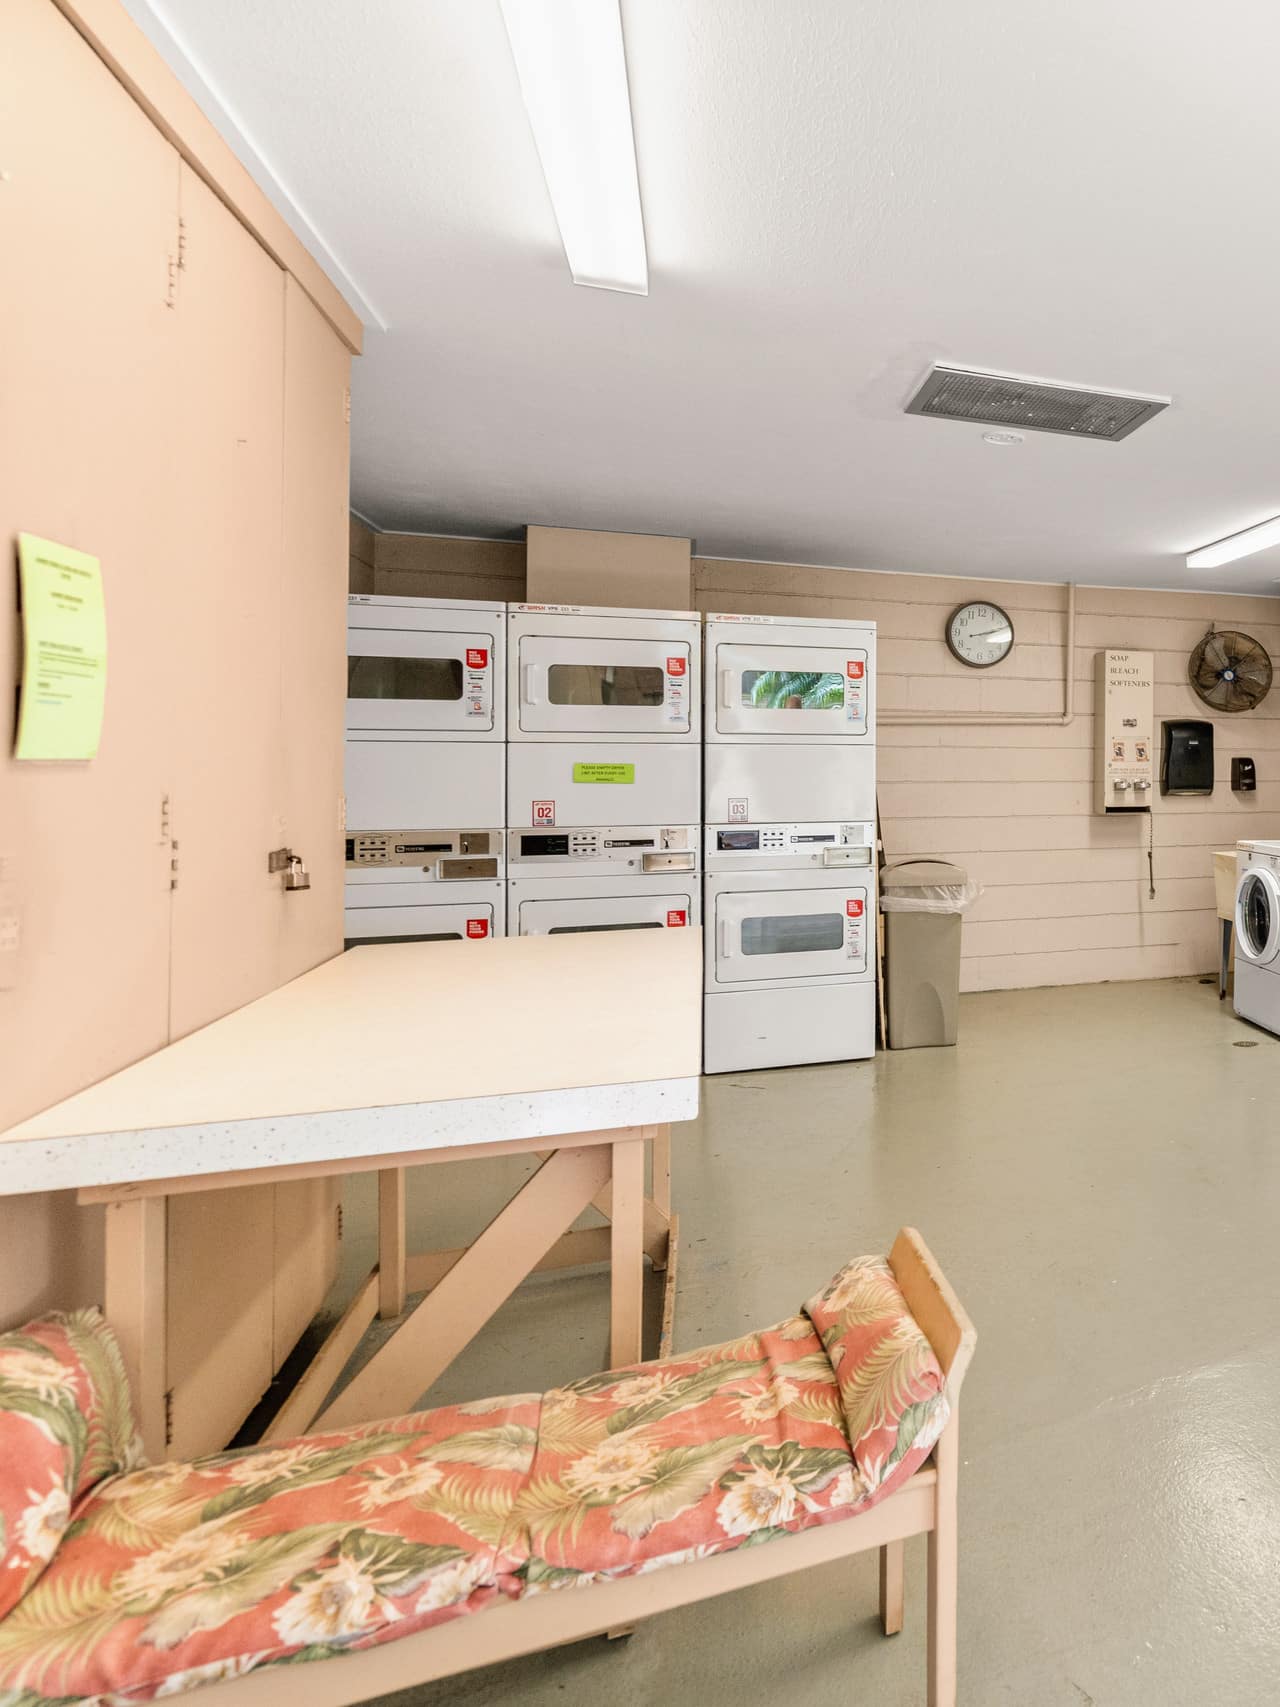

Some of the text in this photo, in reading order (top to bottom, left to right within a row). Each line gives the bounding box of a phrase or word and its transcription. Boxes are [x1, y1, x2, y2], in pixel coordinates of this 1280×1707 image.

[968, 610, 975, 620] 11
[978, 608, 987, 617] 12
[1110, 667, 1139, 675] BLEACH
[1110, 680, 1152, 688] SOFTENERS
[537, 807, 552, 818] 02
[732, 804, 745, 815] 03
